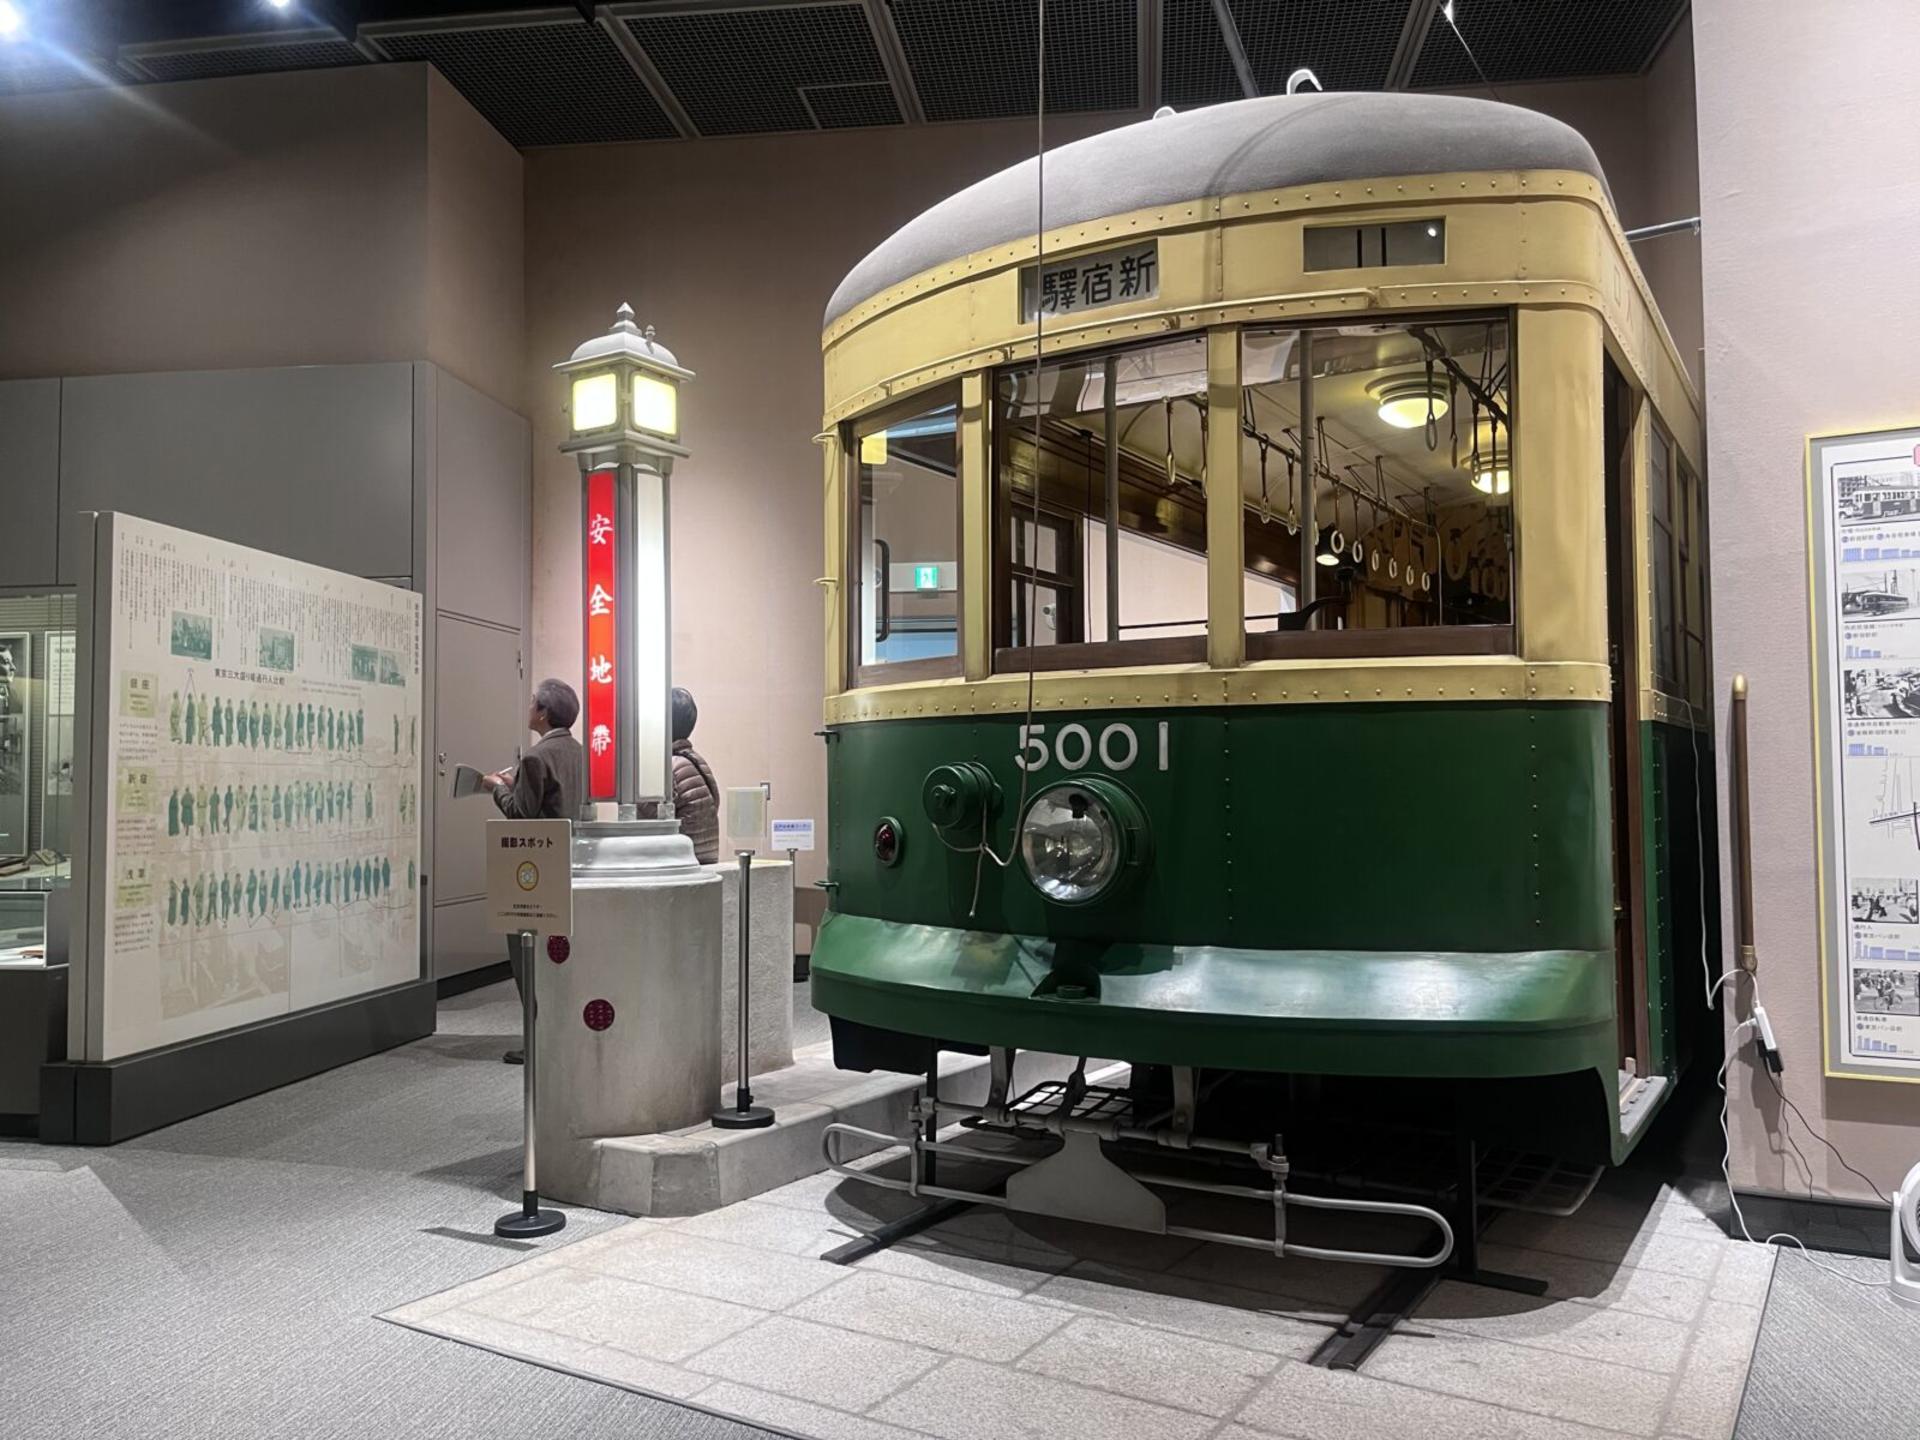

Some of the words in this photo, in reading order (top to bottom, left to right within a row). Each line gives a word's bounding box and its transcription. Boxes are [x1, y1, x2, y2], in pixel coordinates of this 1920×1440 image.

[1014, 721, 1169, 772] 5001
[501, 836, 553, 849] 撮影スポット
